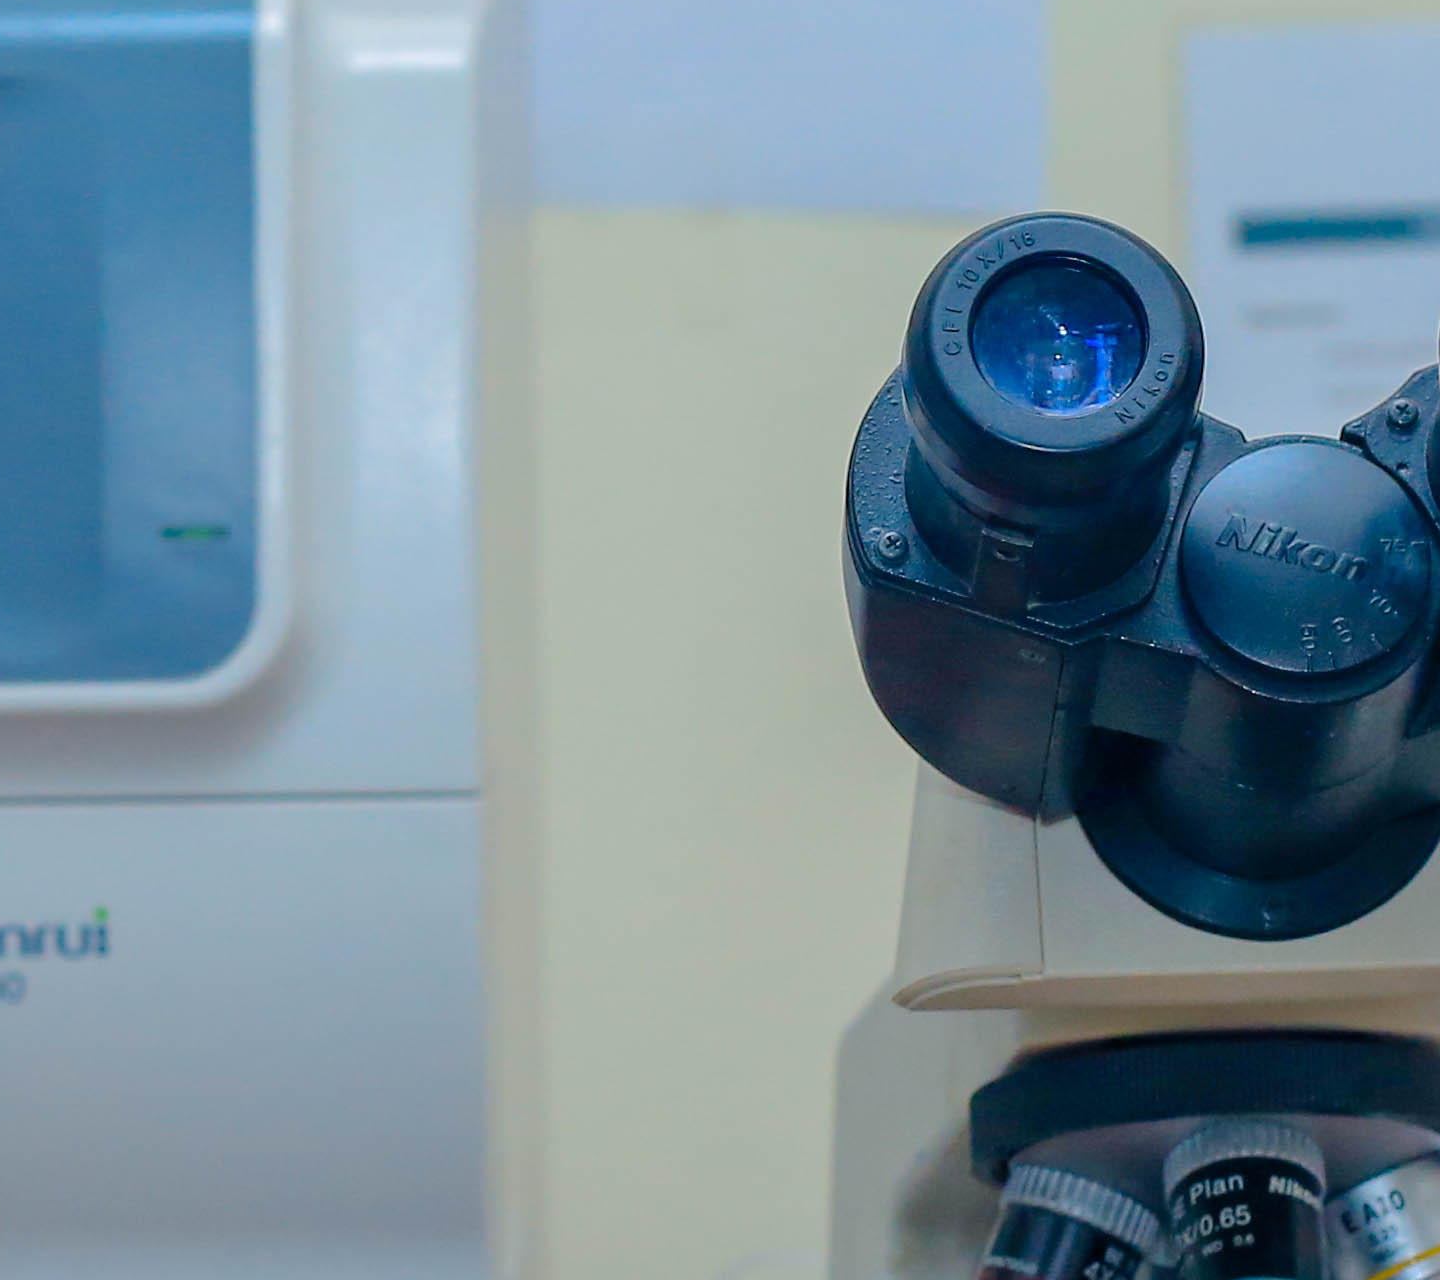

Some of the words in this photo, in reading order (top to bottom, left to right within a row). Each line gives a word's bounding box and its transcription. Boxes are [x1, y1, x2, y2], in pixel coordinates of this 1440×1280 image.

[943, 305, 964, 357] CFI
[1113, 351, 1176, 426] Nikon
[1216, 512, 1370, 581] Nikon
[1188, 1173, 1245, 1207] Plan
